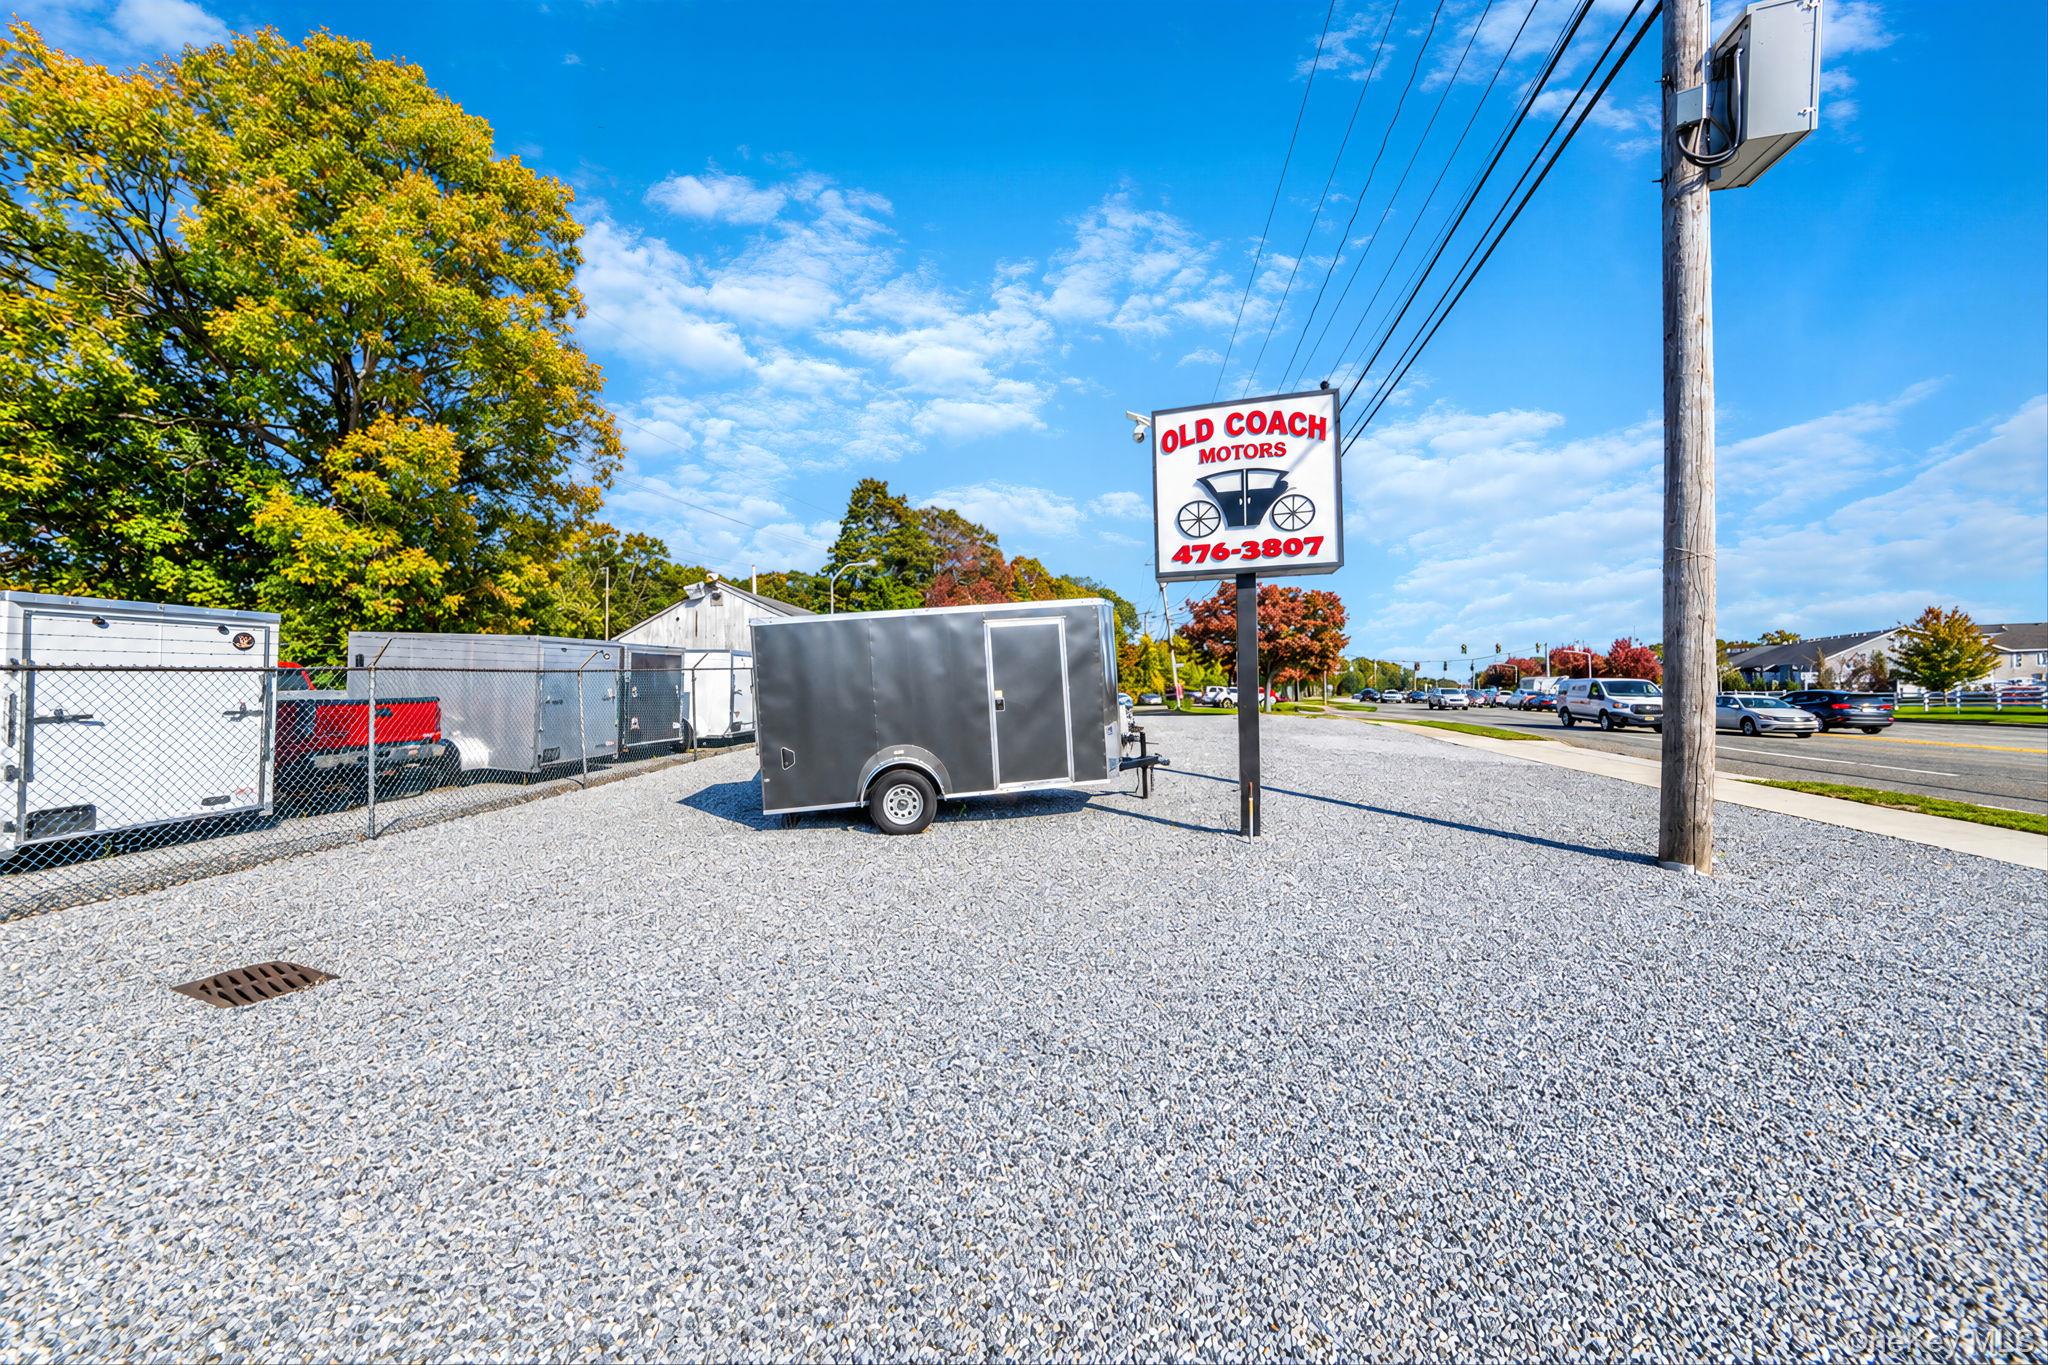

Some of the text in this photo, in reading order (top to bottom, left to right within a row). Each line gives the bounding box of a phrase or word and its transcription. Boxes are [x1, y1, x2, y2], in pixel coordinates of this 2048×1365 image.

[1161, 410, 1327, 454] OLD COACH
[1199, 442, 1287, 464] MOTORS
[1172, 536, 1324, 564] 476-3807
